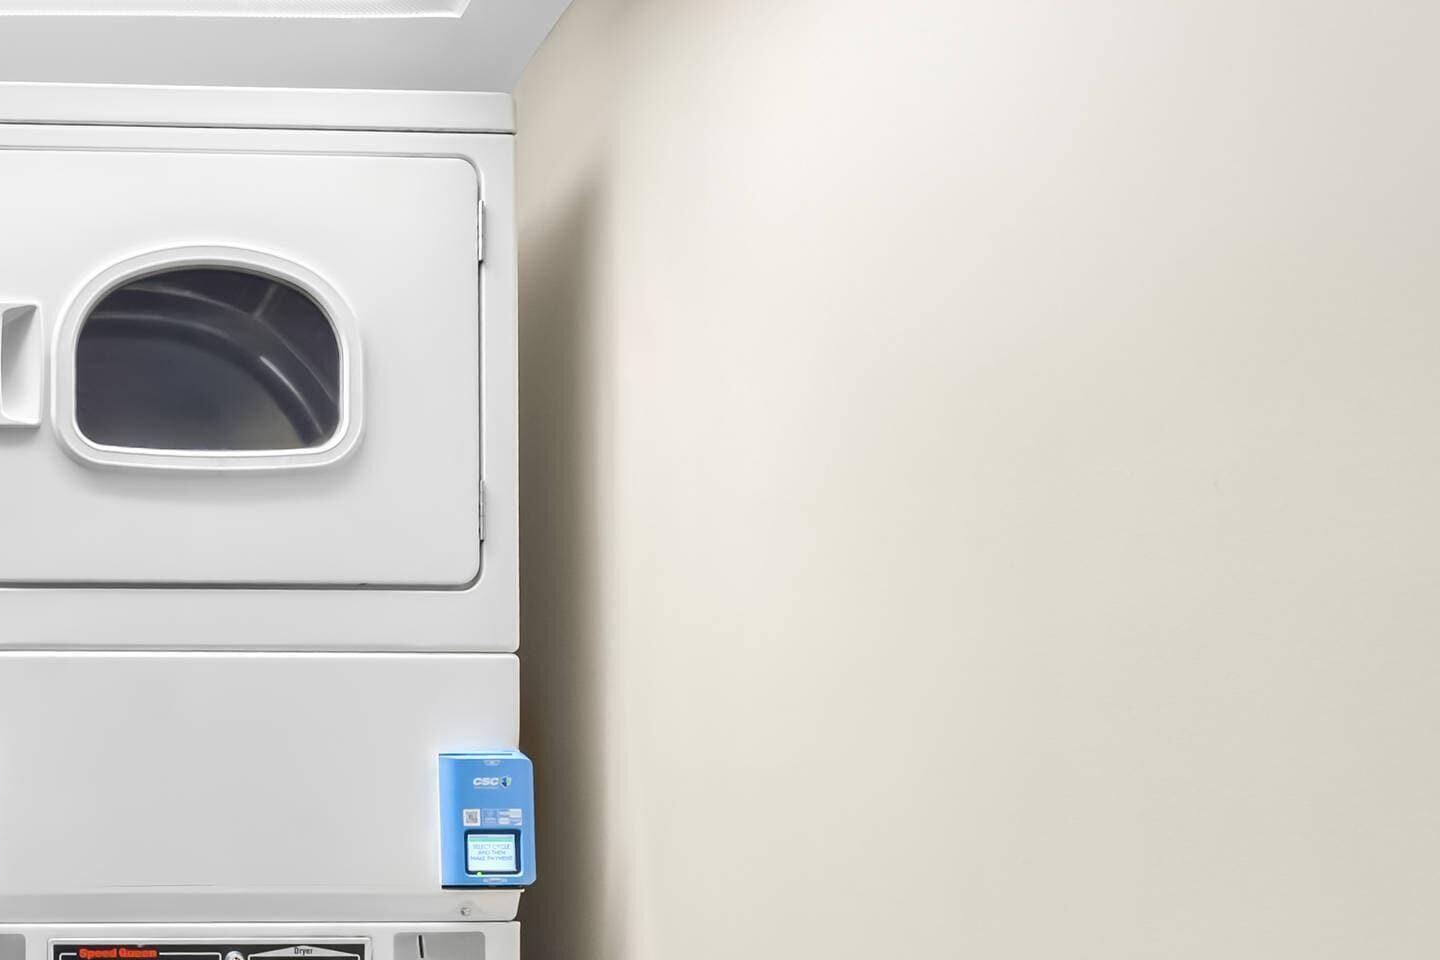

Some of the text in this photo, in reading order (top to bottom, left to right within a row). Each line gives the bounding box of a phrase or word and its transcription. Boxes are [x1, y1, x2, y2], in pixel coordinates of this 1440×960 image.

[472, 777, 499, 786] CSC
[79, 948, 158, 960] Speed Queen
[294, 947, 313, 956] Dryer
